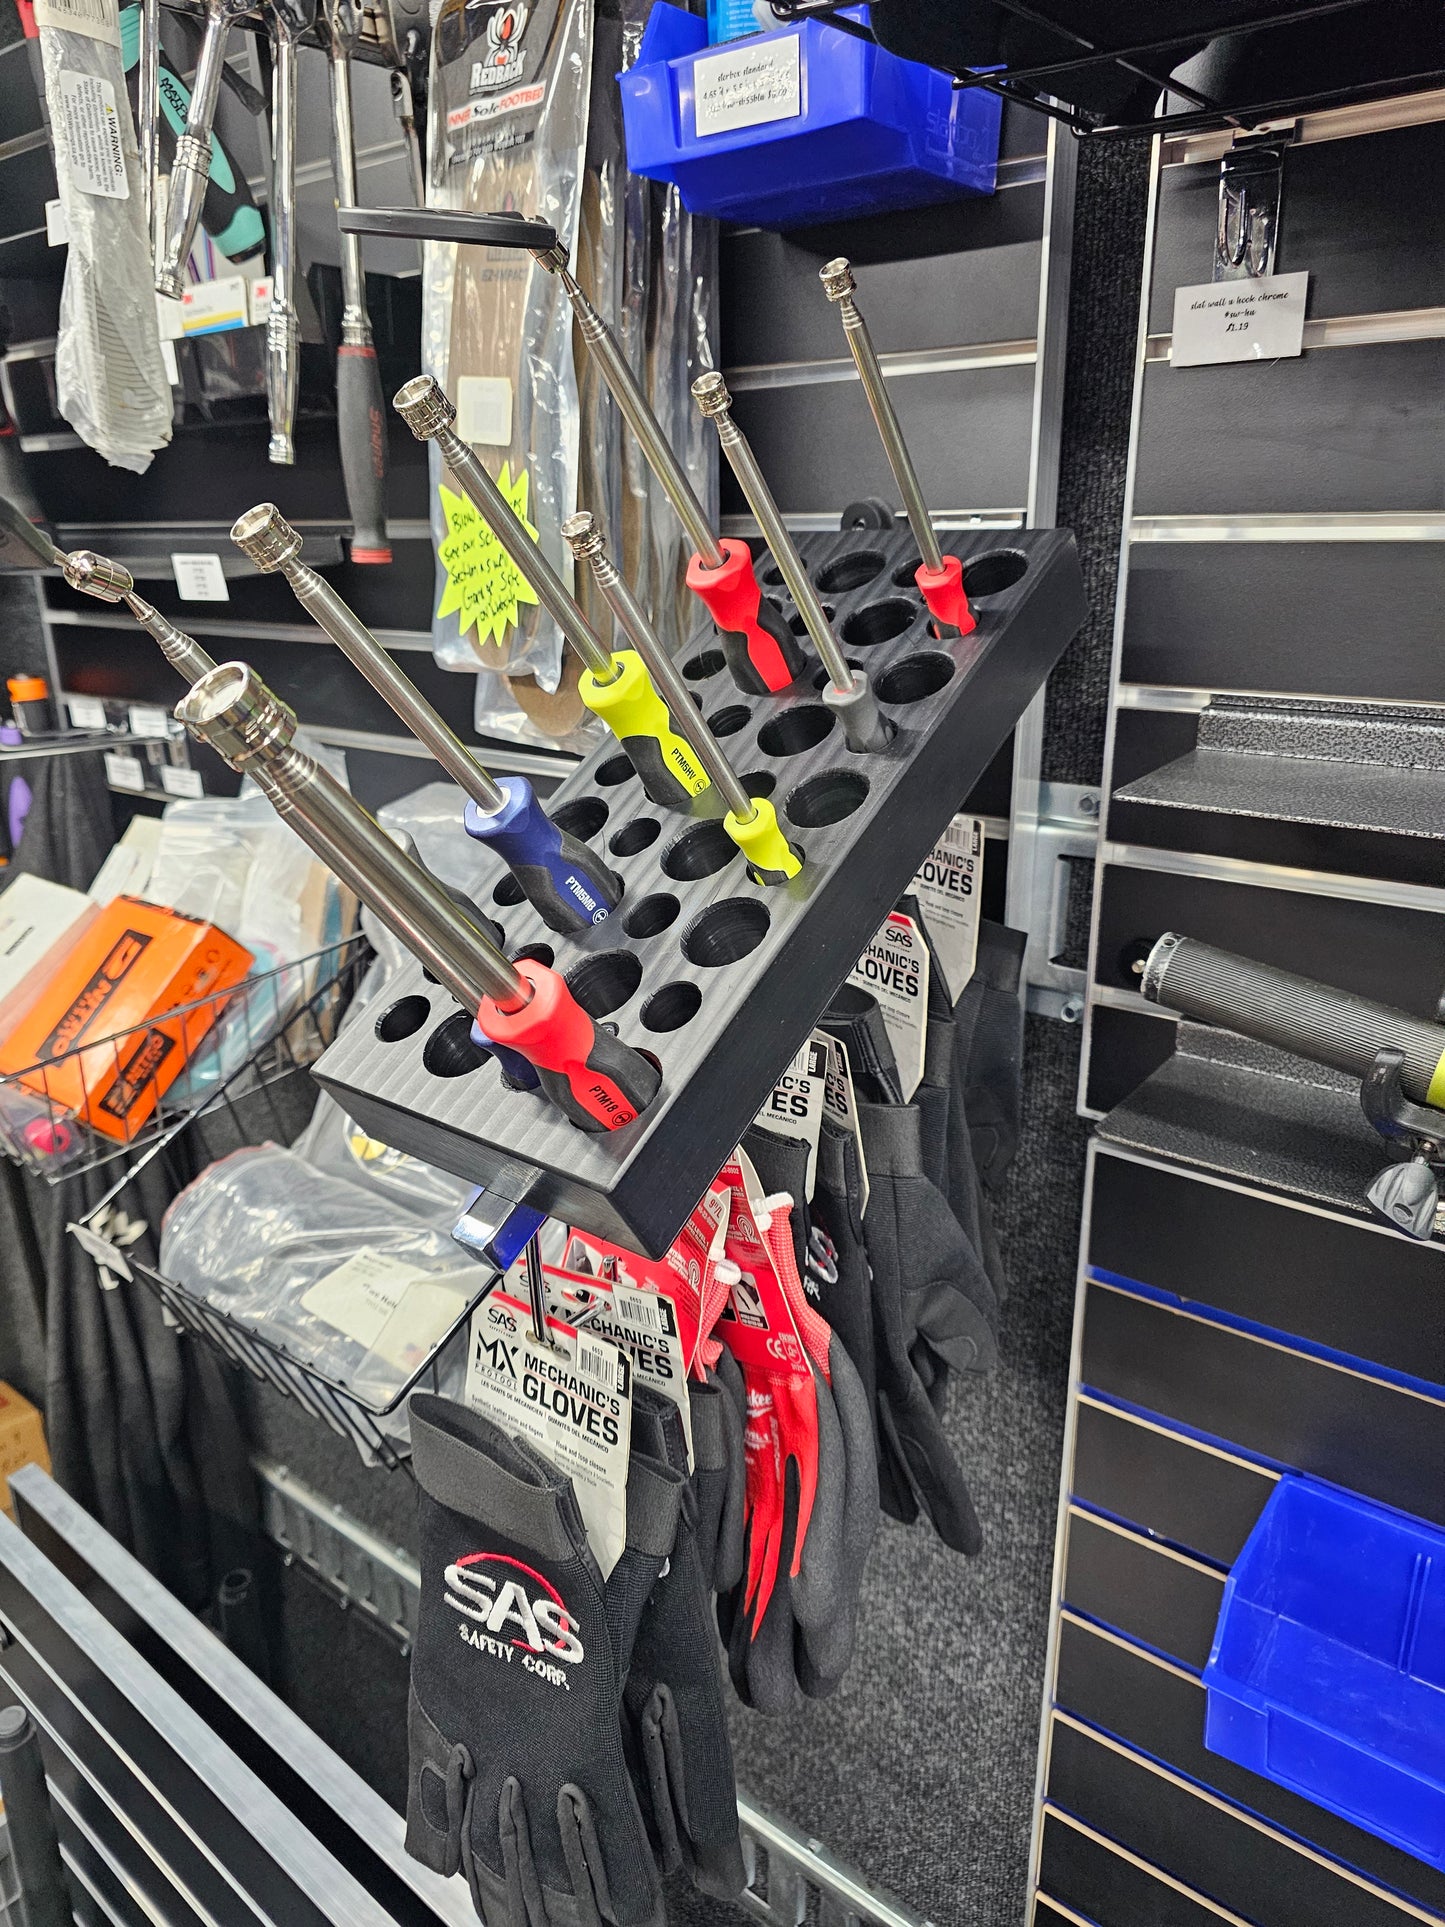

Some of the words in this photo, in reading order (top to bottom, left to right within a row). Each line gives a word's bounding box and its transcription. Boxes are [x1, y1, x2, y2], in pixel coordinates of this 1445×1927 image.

[469, 51, 527, 90] REDBACK
[160, 77, 188, 116] MATC
[499, 86, 545, 111] FOOTBED
[107, 116, 123, 176] WARNING:
[1190, 301, 1206, 310] slat
[1207, 298, 1227, 308] wall
[1236, 294, 1256, 305] hook
[1257, 291, 1289, 302] chrome
[1225, 322, 1249, 333] $1.19
[671, 747, 697, 780] PTM5HV
[929, 848, 974, 873] HANIC'S
[916, 862, 973, 895] OVES
[565, 876, 596, 911] PTM5MB
[885, 927, 912, 948] SAS
[865, 945, 919, 974] HANIC'S
[856, 959, 919, 997] LOVES
[808, 1051, 818, 1073] LARGE
[589, 1085, 619, 1112] PTM18
[487, 1307, 518, 1333] SAS
[660, 1308, 670, 1332] LARGE
[476, 1330, 519, 1379] MX
[591, 1345, 604, 1356] 6653
[475, 1362, 518, 1391] PROTOOL
[524, 1352, 620, 1416] MECHANIC'S
[617, 1363, 625, 1391] LARGE
[522, 1373, 619, 1446] GLOVES
[443, 1564, 584, 1664] SAS
[458, 1623, 514, 1663] SAFETY
[521, 1654, 570, 1691] CORP.
